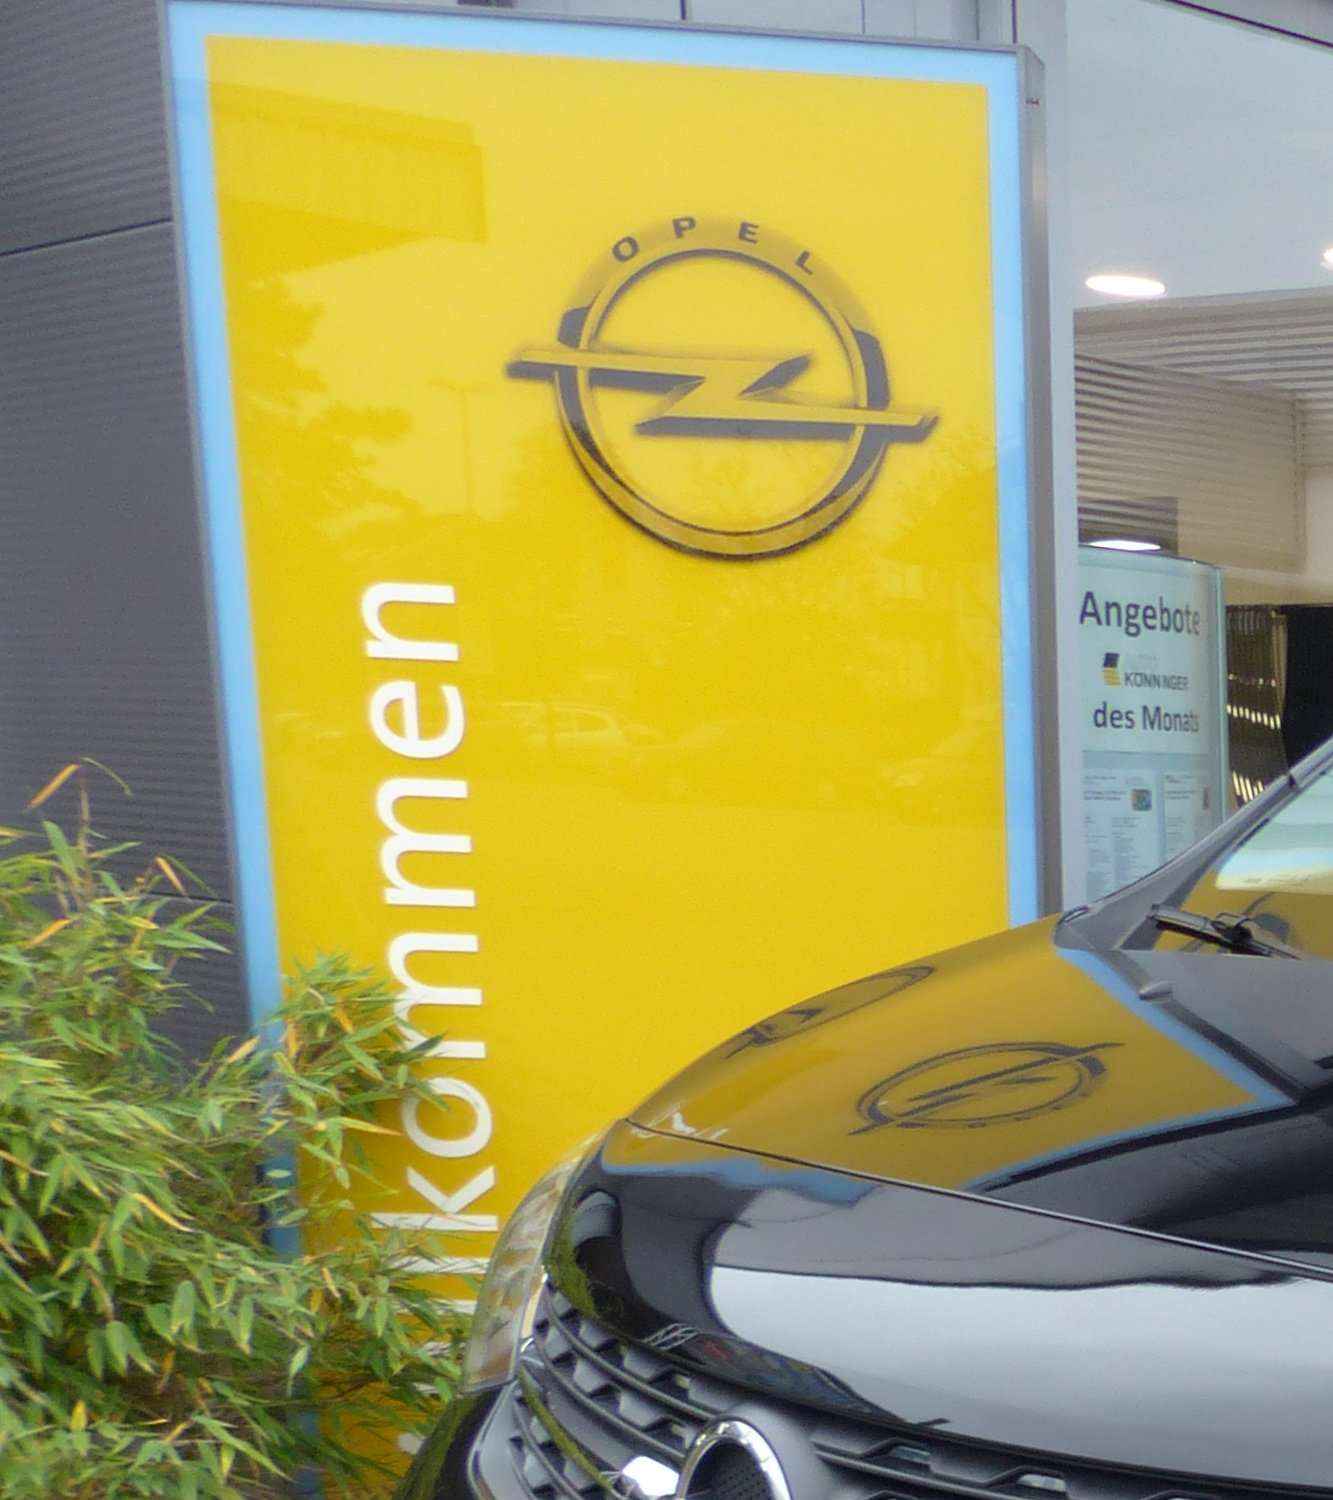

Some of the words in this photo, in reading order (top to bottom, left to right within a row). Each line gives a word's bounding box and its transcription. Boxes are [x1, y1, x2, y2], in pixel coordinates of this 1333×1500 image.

[611, 216, 814, 276] OPEL
[1079, 591, 1200, 638] Angebote
[1093, 701, 1135, 730] des
